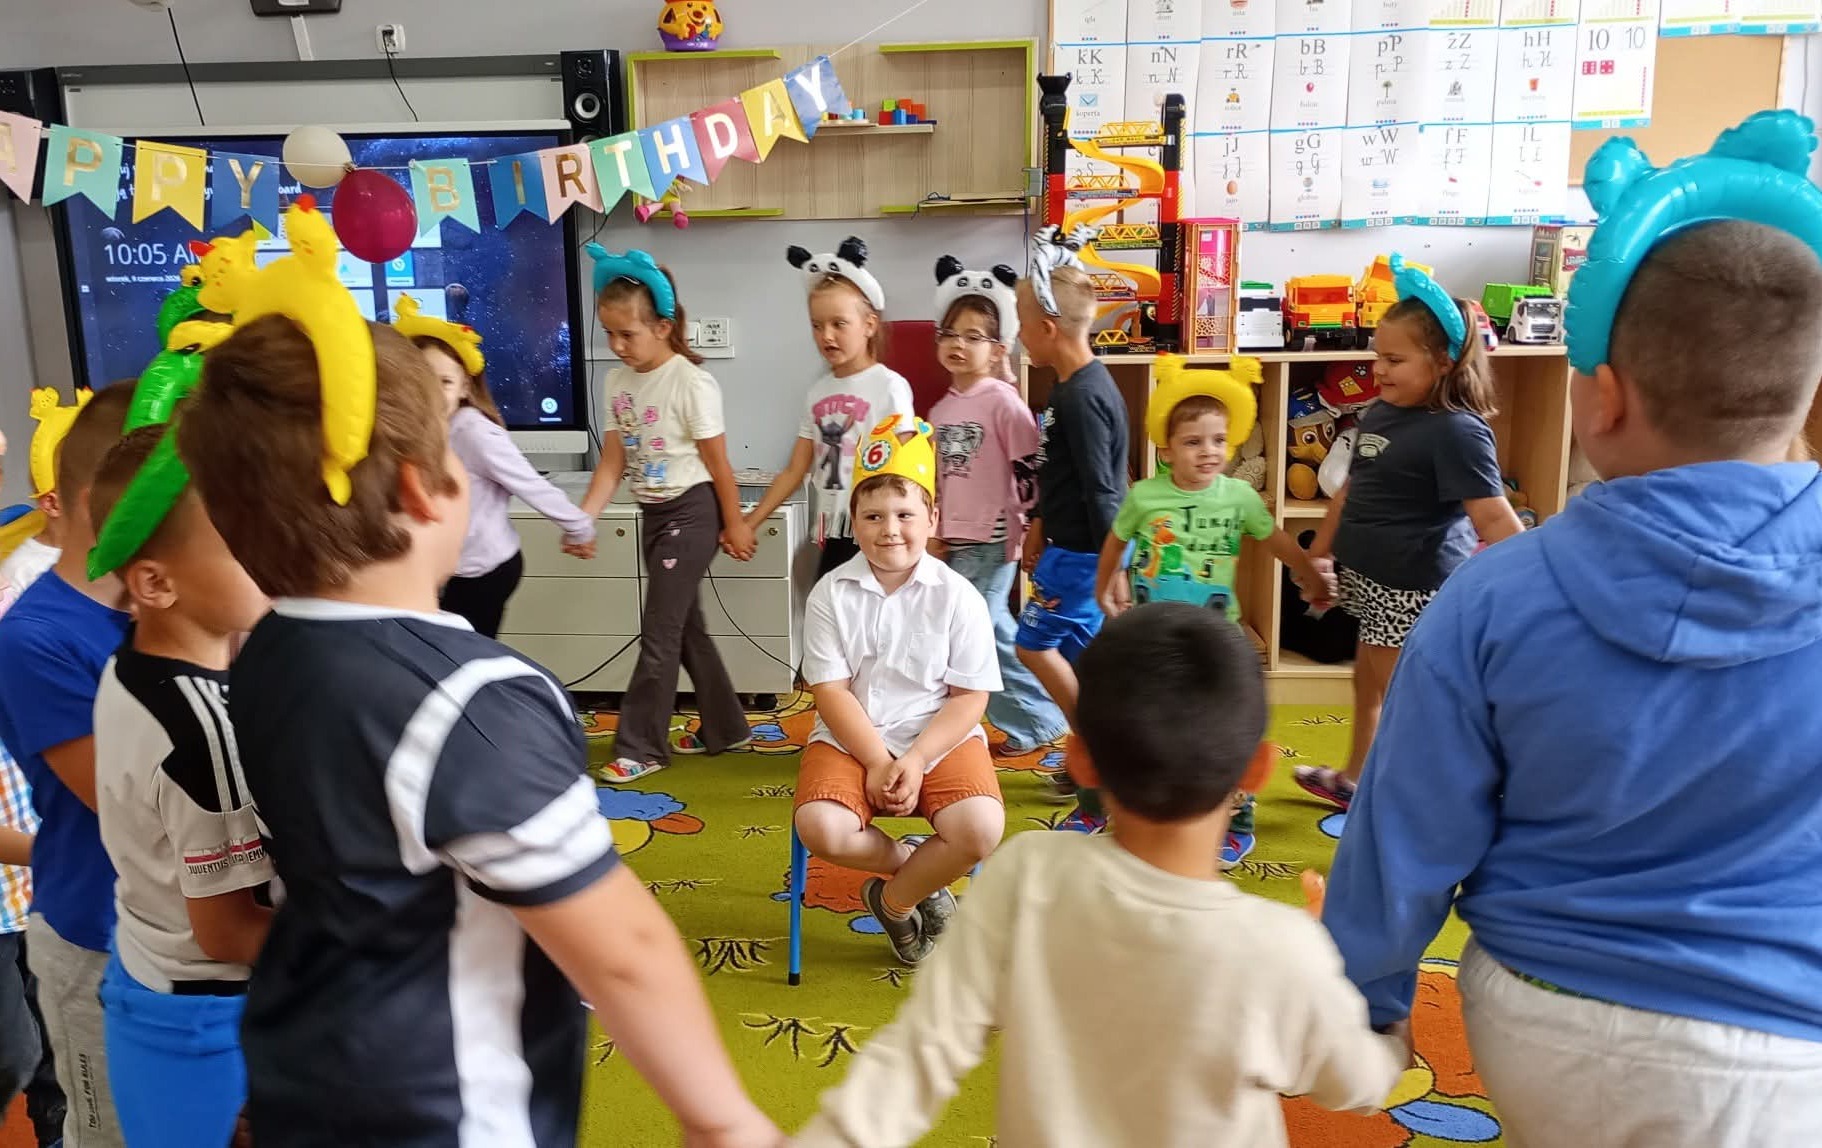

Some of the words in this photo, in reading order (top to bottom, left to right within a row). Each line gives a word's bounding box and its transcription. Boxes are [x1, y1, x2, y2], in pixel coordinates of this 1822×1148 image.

[1300, 39, 1326, 55] bB
[1378, 35, 1403, 57] pP
[1589, 28, 1610, 51] 10
[1626, 26, 1646, 49] 10
[1078, 48, 1103, 65] kK
[1226, 43, 1248, 59] rR
[428, 62, 828, 212] BIRTHDAY
[1294, 133, 1321, 154] gG
[104, 243, 167, 265] 10:05
[868, 443, 883, 465] 6
[188, 858, 230, 875] JUVENTUS
